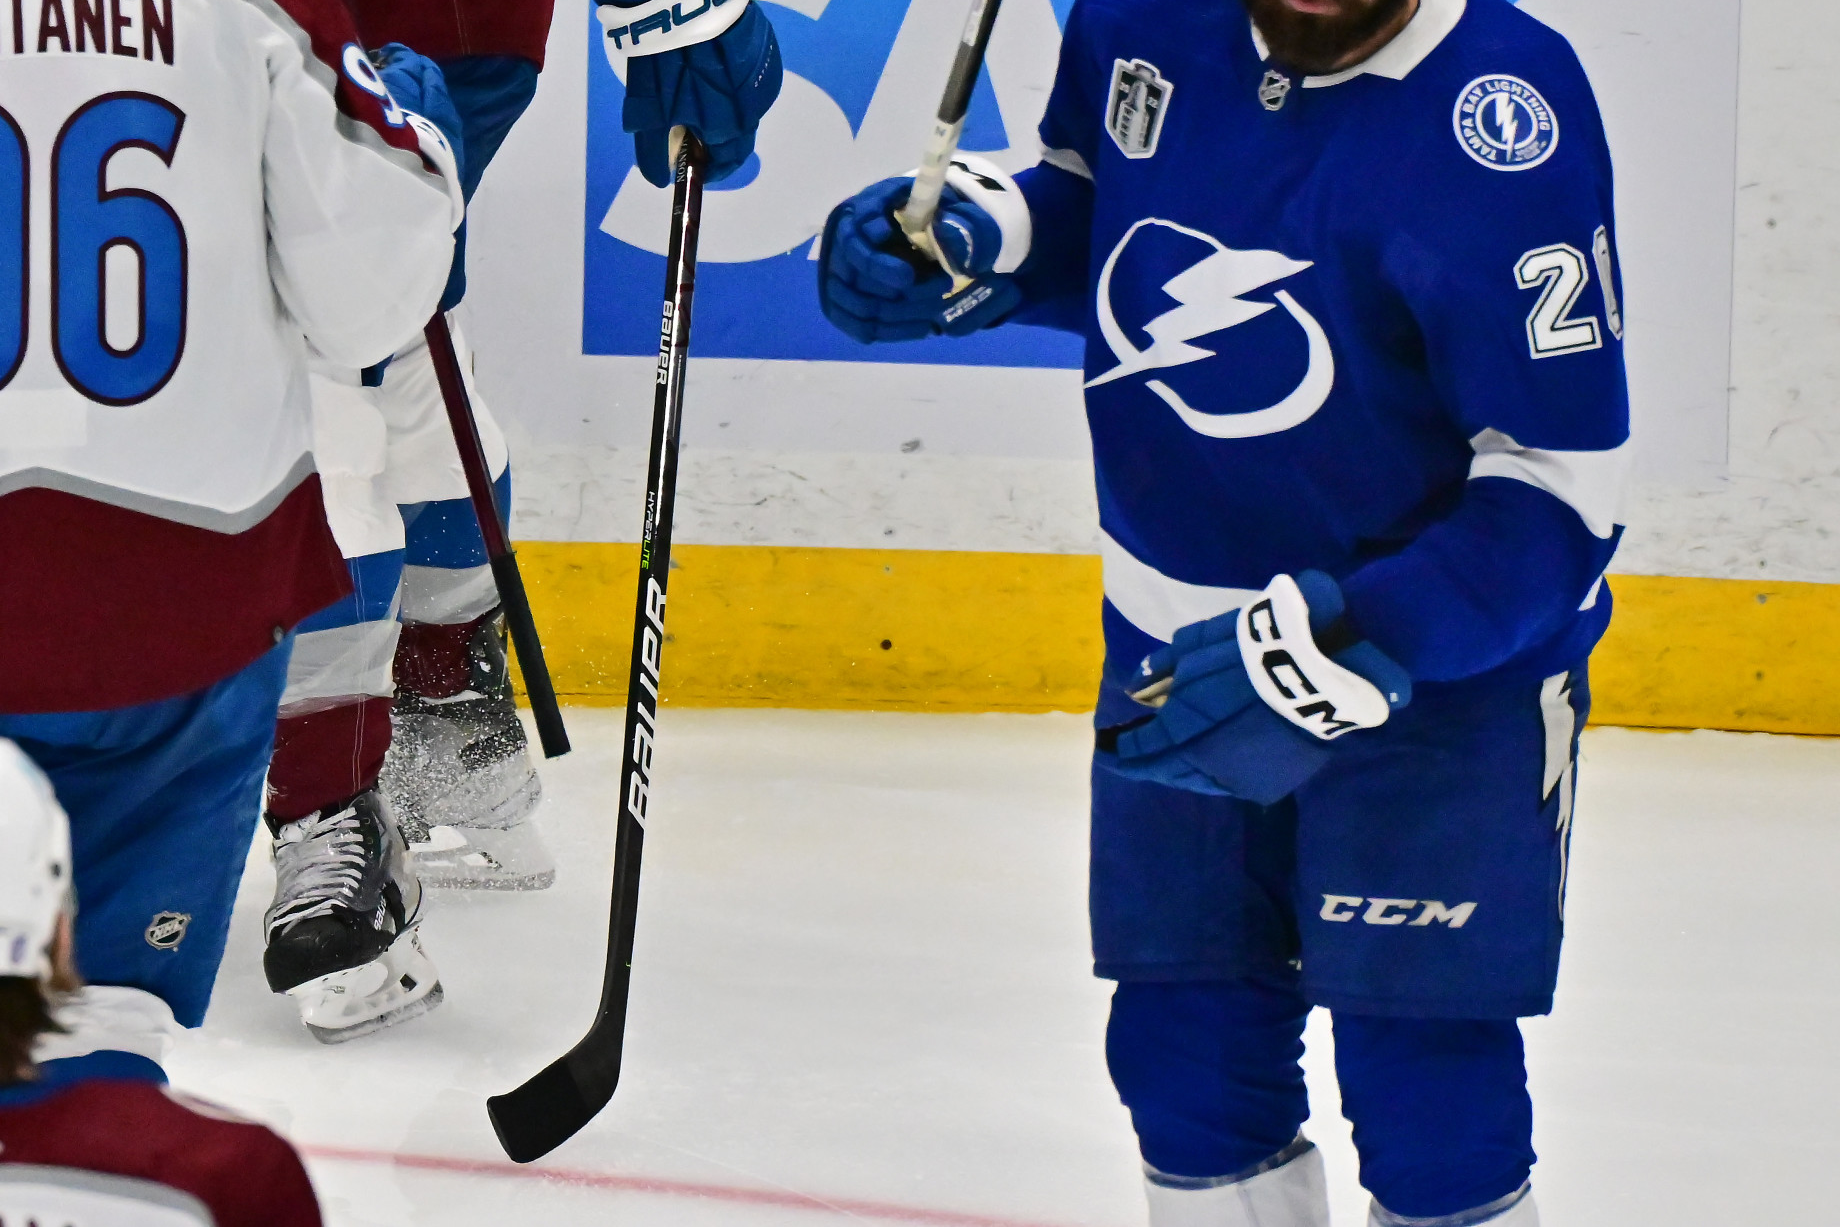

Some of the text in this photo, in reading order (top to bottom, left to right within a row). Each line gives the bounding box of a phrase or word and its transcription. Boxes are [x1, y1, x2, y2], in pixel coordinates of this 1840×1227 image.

[655, 300, 674, 385] BAUER
[640, 490, 655, 570] HYPERLITE
[627, 576, 667, 831] BAUER
[1245, 598, 1359, 737] CCM
[1320, 894, 1478, 928] CCM
